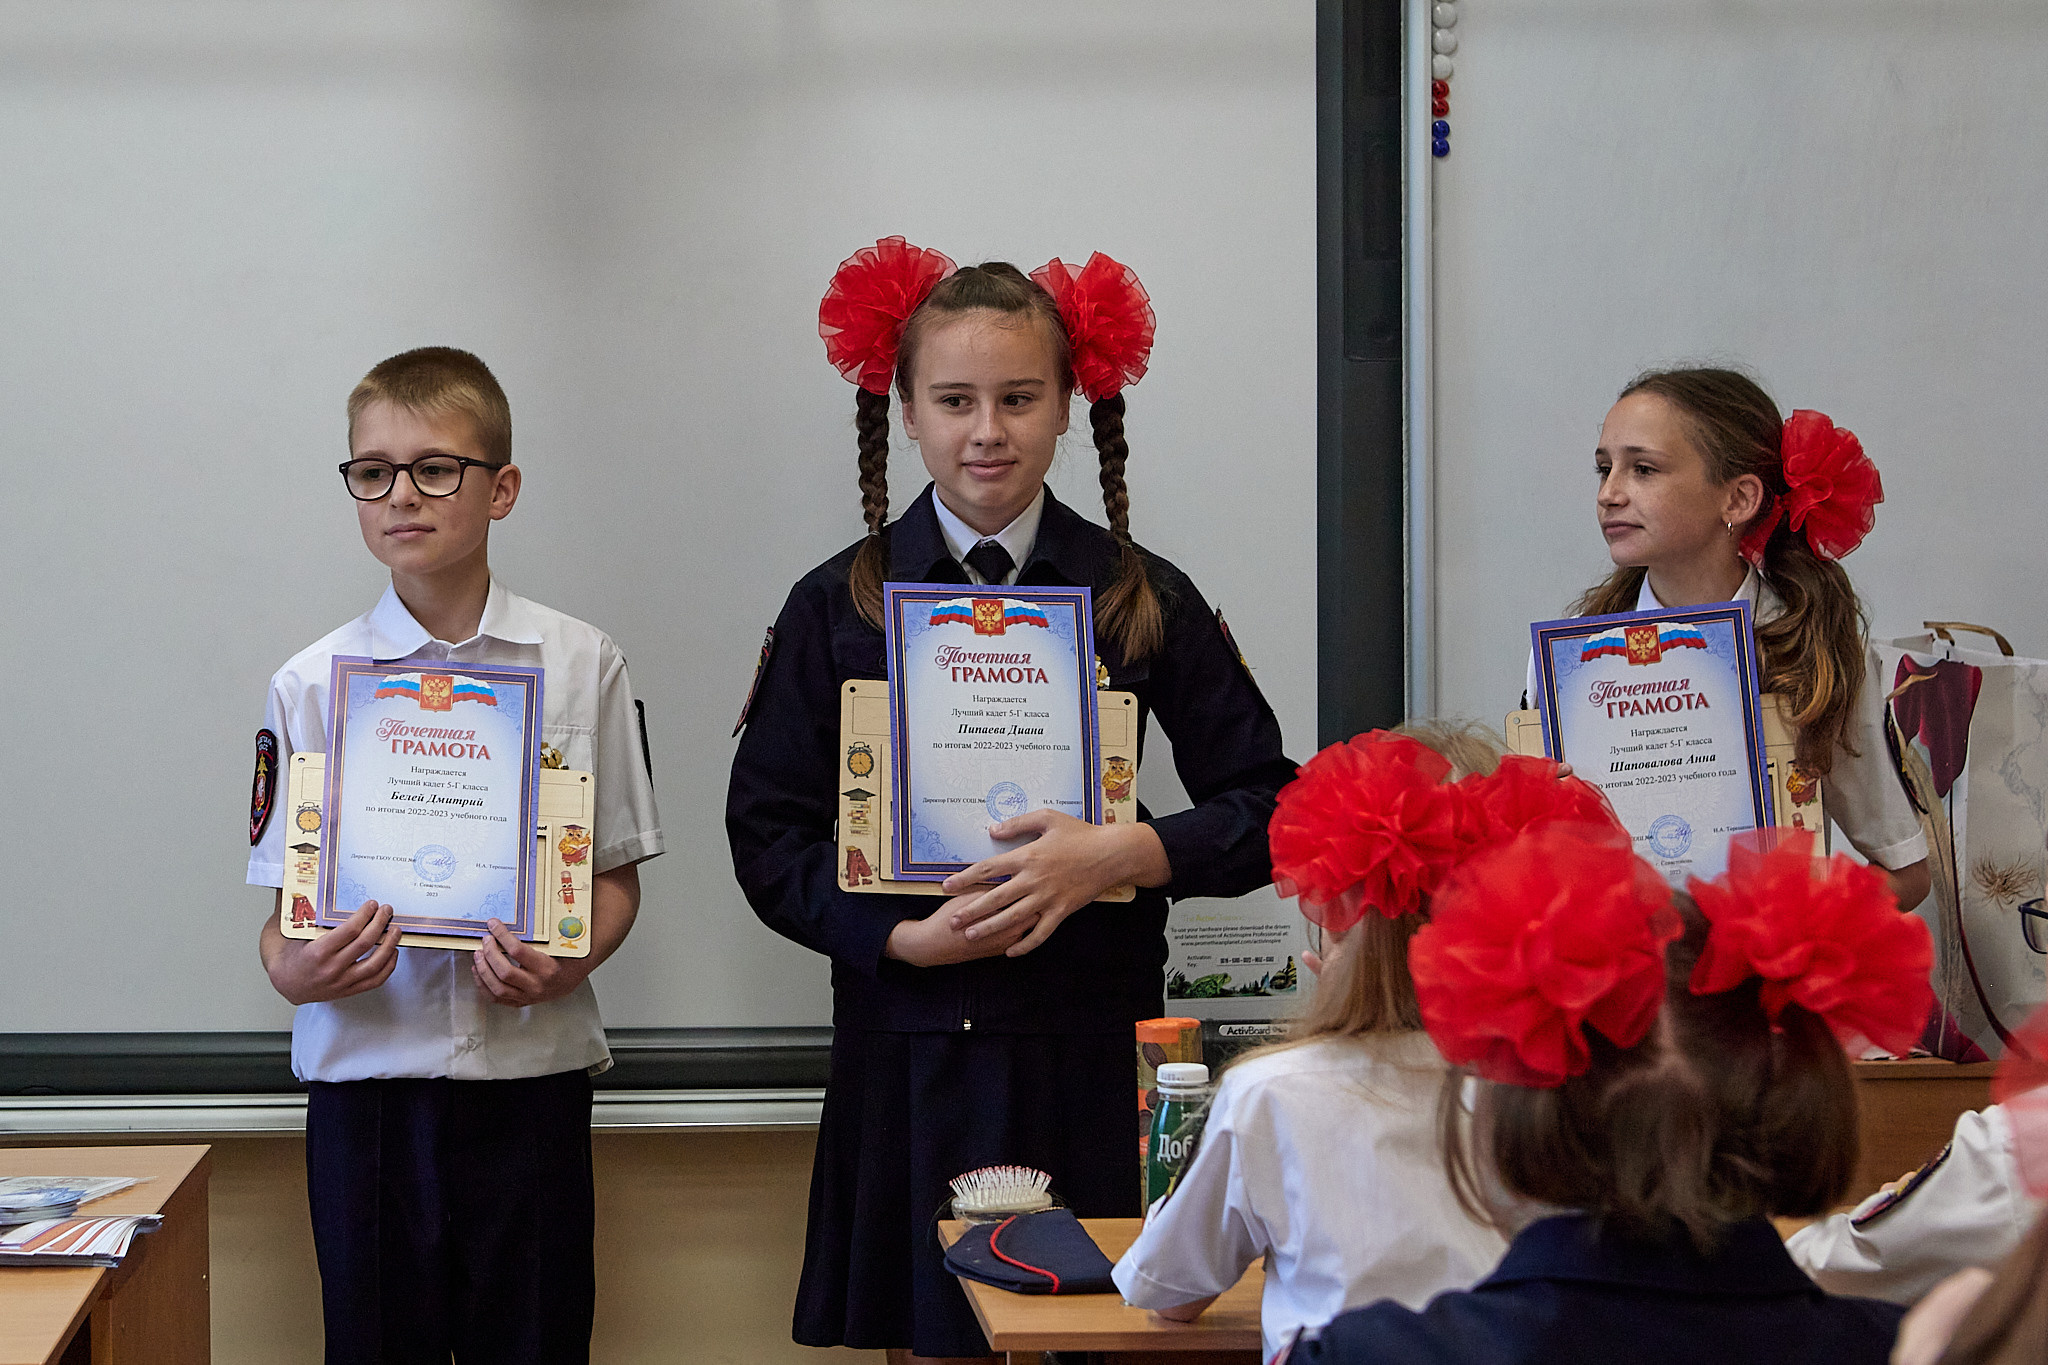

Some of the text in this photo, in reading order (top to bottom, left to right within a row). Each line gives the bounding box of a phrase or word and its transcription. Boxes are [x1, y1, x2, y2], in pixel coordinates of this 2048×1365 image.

[935, 645, 1031, 670] Почетная
[952, 667, 1049, 684] ГРАМОТА
[973, 695, 1027, 704] Награждается
[1589, 678, 1690, 707] Почетная
[951, 708, 983, 717] Лучший
[1607, 693, 1710, 719] ГРАМОТА
[376, 718, 476, 741] Почетная
[958, 724, 1044, 736] Пипаева Диана
[1631, 726, 1687, 737] Награждается
[391, 739, 491, 760] ГРАМОТА
[1016, 742, 1051, 751] учебного
[1610, 744, 1643, 754] Лучший
[1646, 743, 1667, 751] кадет
[1686, 738, 1712, 746] класса
[1610, 754, 1716, 772] Шаповалова Анна
[411, 766, 467, 777] Награждается
[387, 777, 421, 786] Лучший
[1605, 781, 1633, 789] итогам
[1636, 775, 1676, 786] 2022-2023
[1679, 772, 1716, 782] учебного
[391, 791, 484, 807] Белей Дмитрий
[408, 808, 448, 817] 2022-2023
[450, 812, 488, 820] учебного
[1227, 1026, 1270, 1034] ActivBoard
